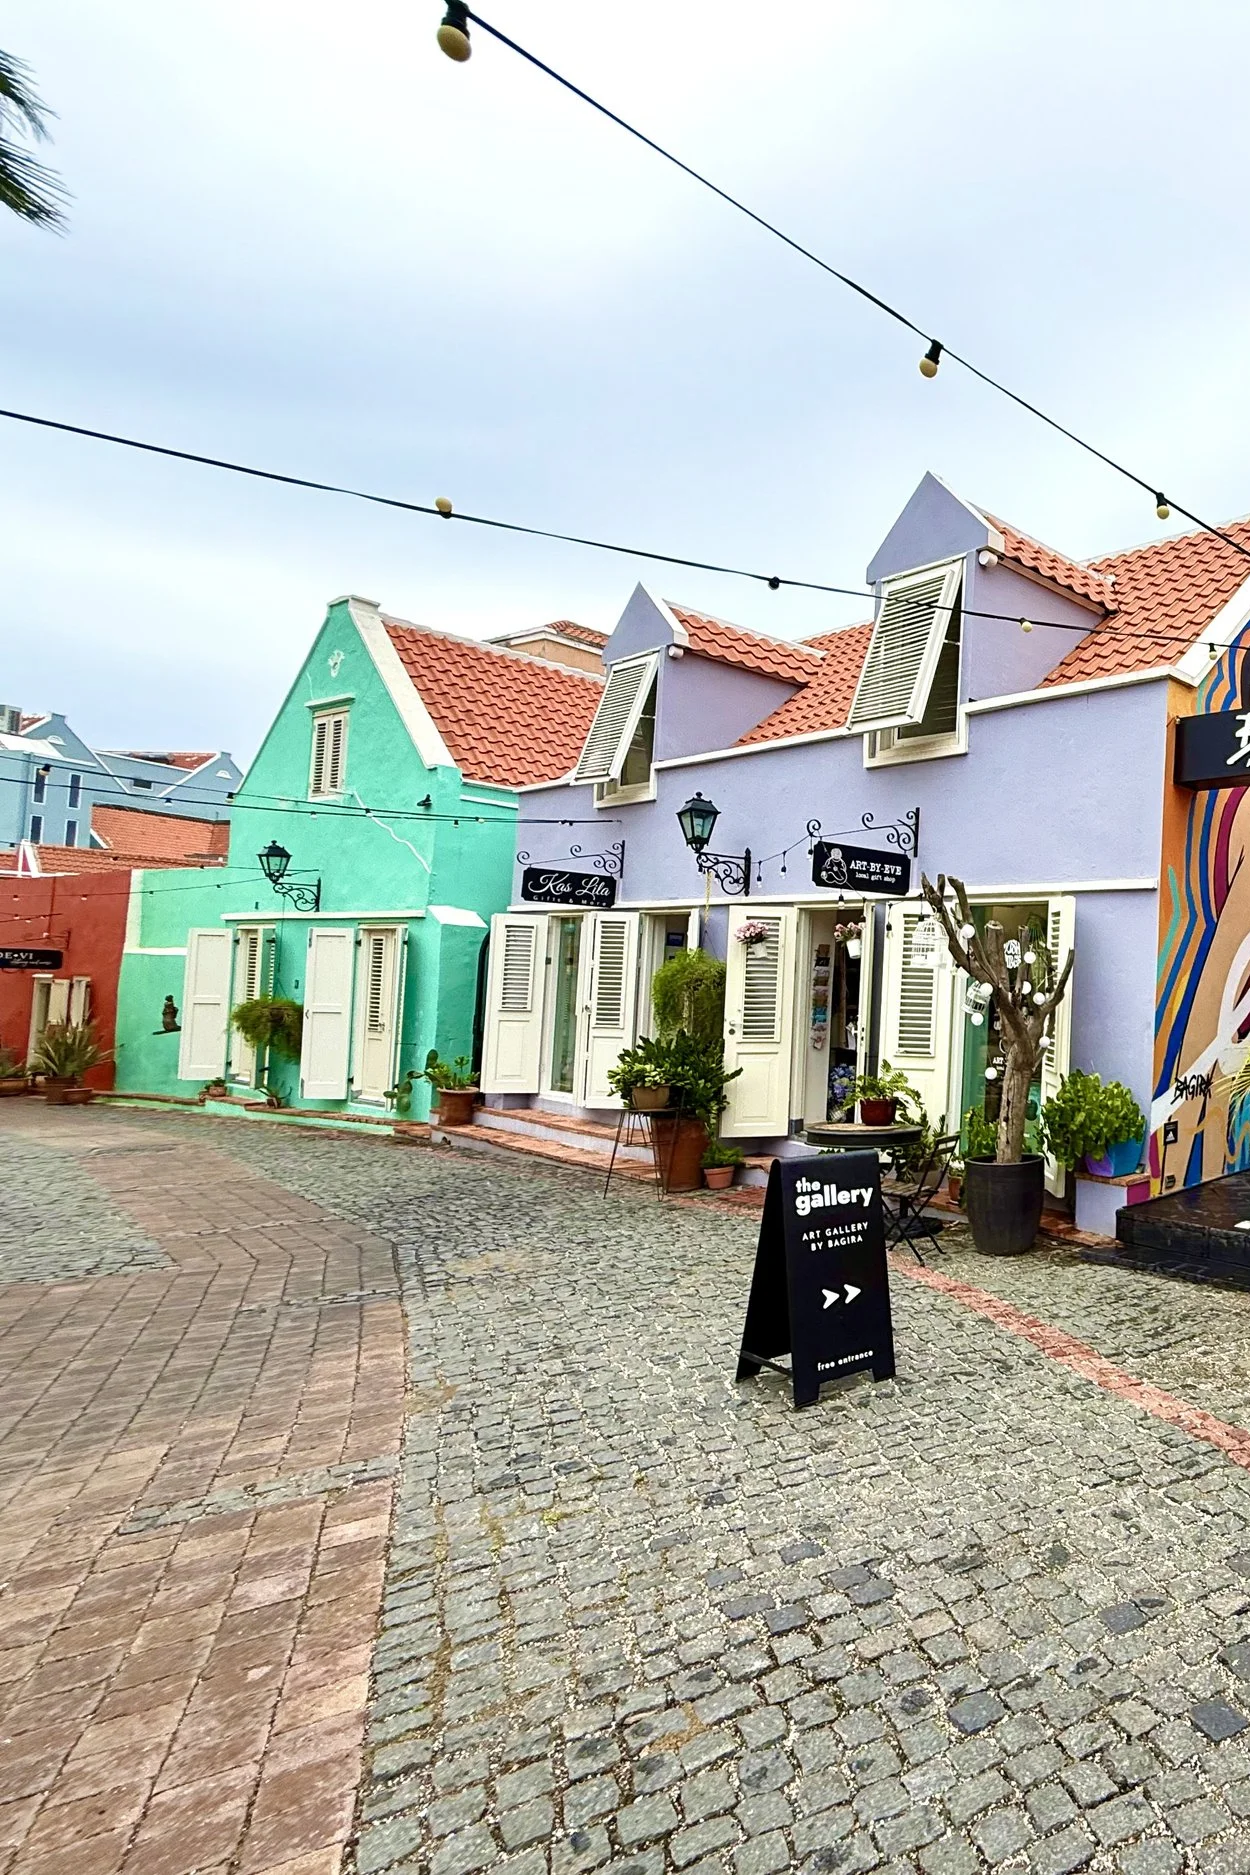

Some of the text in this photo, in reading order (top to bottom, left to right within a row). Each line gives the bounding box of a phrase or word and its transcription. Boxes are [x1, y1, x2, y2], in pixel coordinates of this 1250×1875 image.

[849, 860, 902, 876] ART-BY-EVE
[855, 871, 896, 884] local gift shop
[528, 873, 611, 901] Kas Lila
[1170, 1072, 1213, 1105] BAGIRA
[795, 1176, 821, 1193] the
[795, 1183, 874, 1216] gallery
[802, 1221, 869, 1242] ART GALLERY
[810, 1234, 863, 1252] BY BAGIRA
[817, 1350, 874, 1372] free entrance
